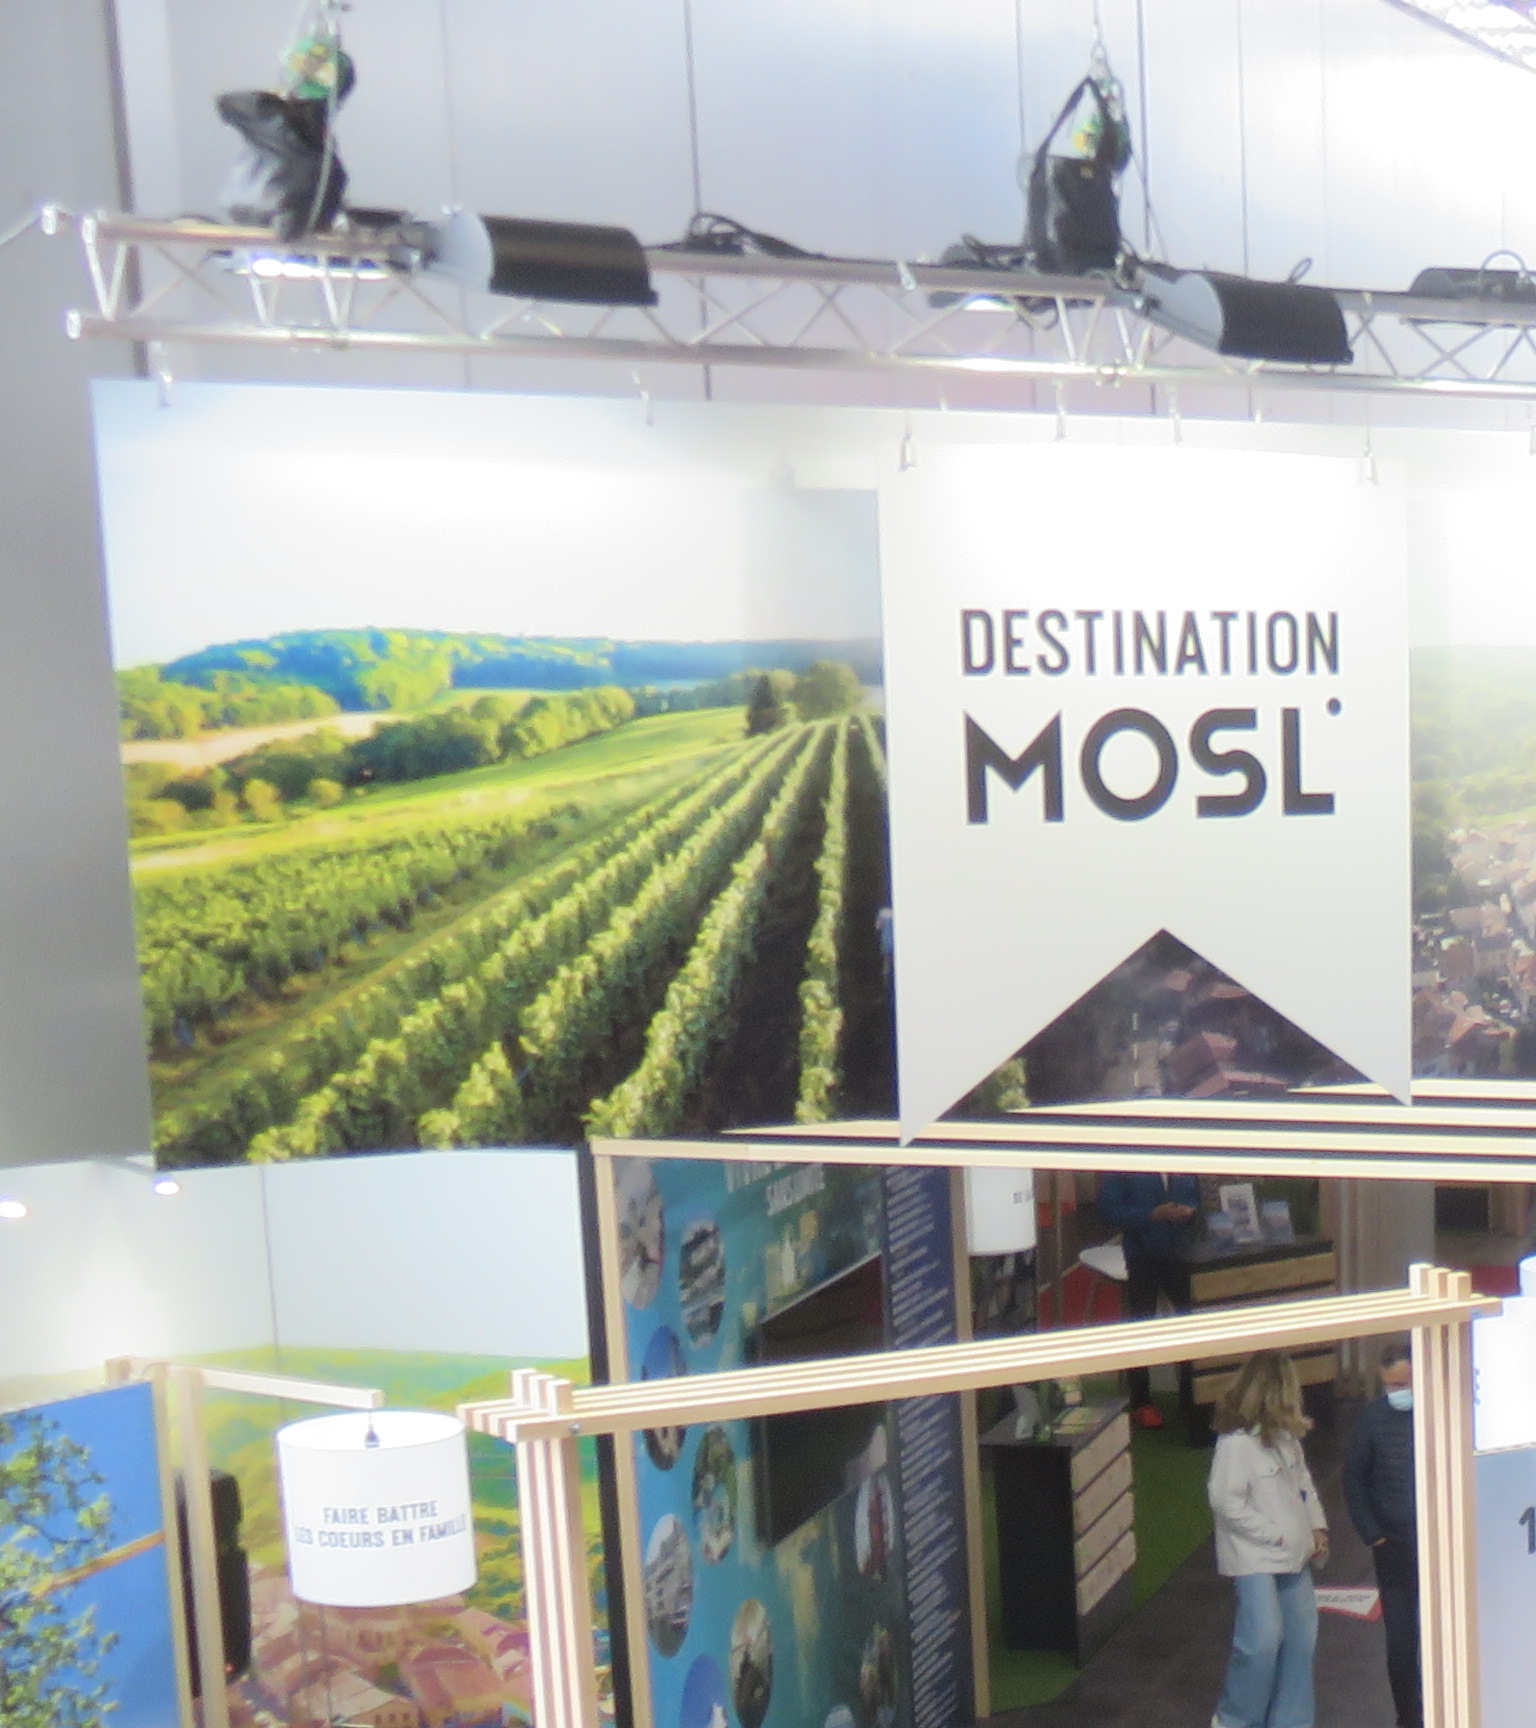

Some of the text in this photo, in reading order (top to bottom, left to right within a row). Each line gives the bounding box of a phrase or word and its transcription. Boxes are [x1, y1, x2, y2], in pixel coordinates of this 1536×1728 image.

[960, 609, 1340, 677] DESTINATION
[323, 1500, 439, 1525] FAIRE BATTRE
[318, 1530, 385, 1549] COEURS
[391, 1528, 414, 1547] EN
